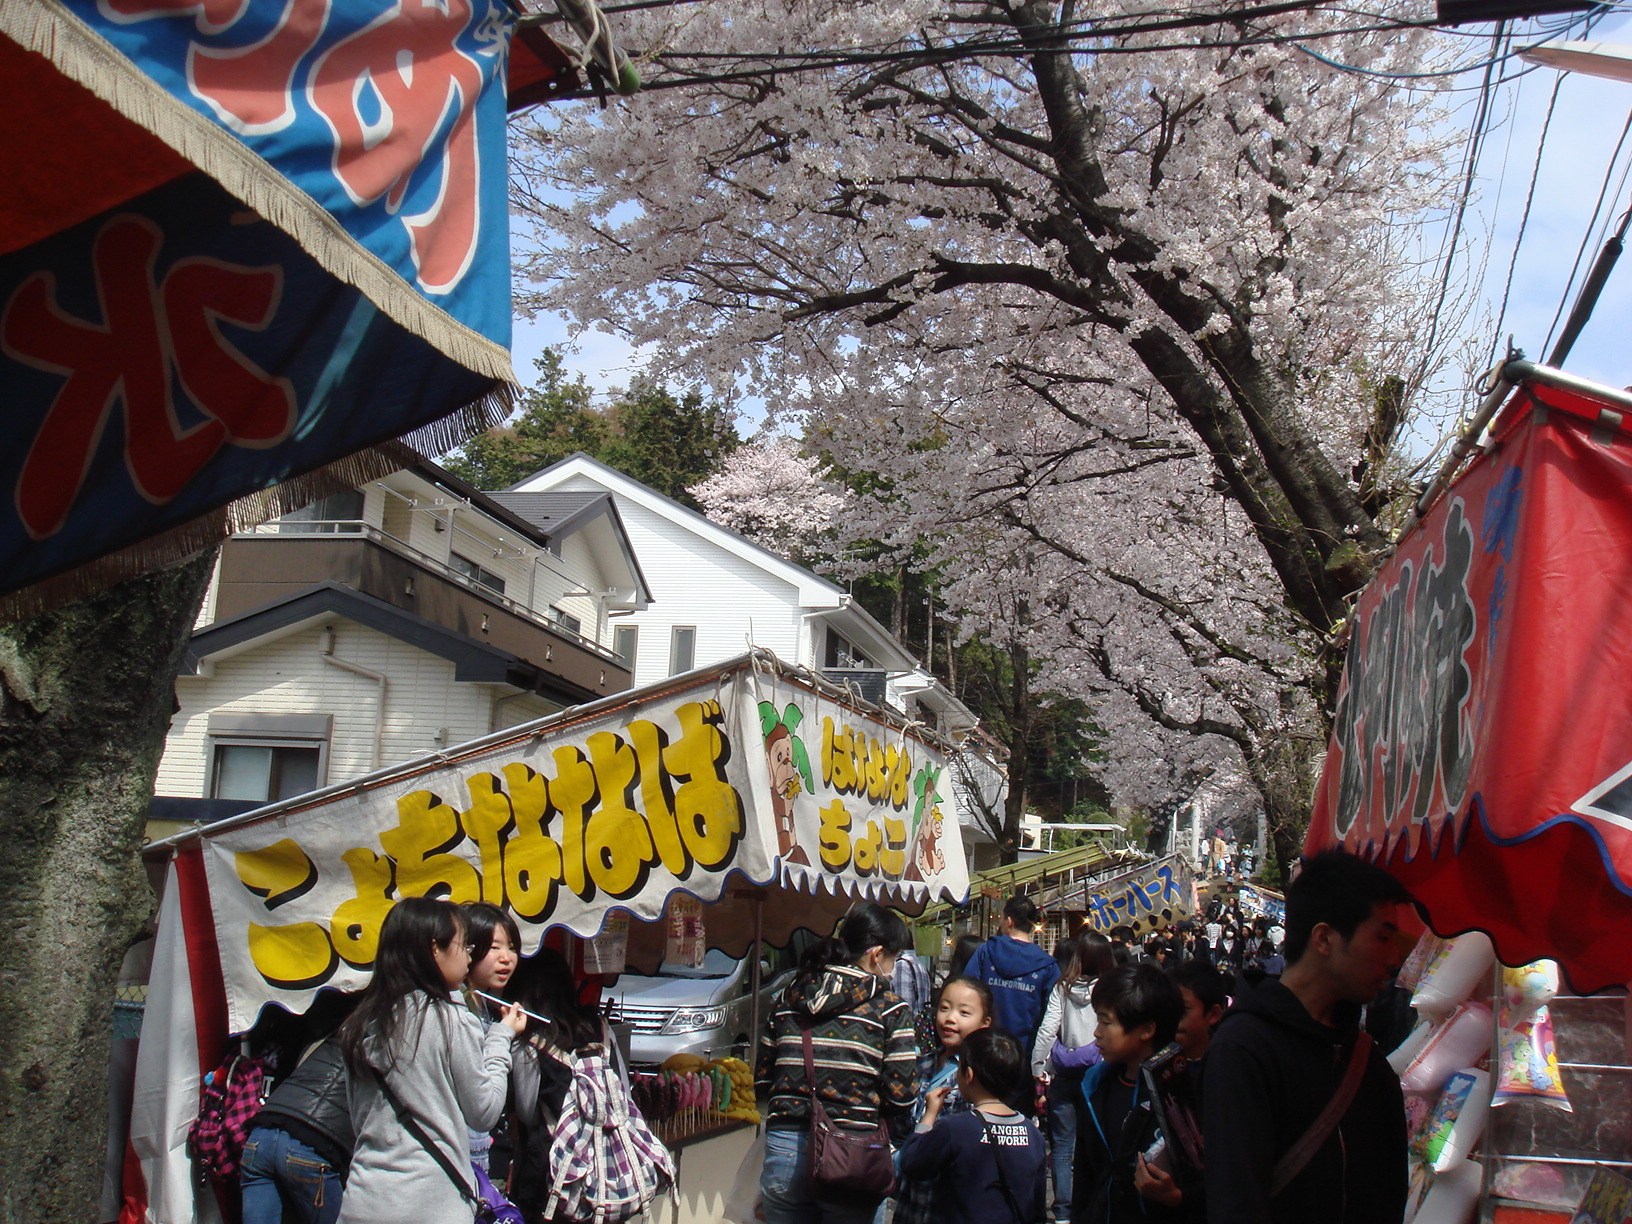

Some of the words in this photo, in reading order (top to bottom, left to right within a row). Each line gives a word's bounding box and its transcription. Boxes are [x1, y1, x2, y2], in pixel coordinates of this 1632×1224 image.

[821, 715, 911, 812] ばなな
[997, 1135, 1029, 1146] WORK!
